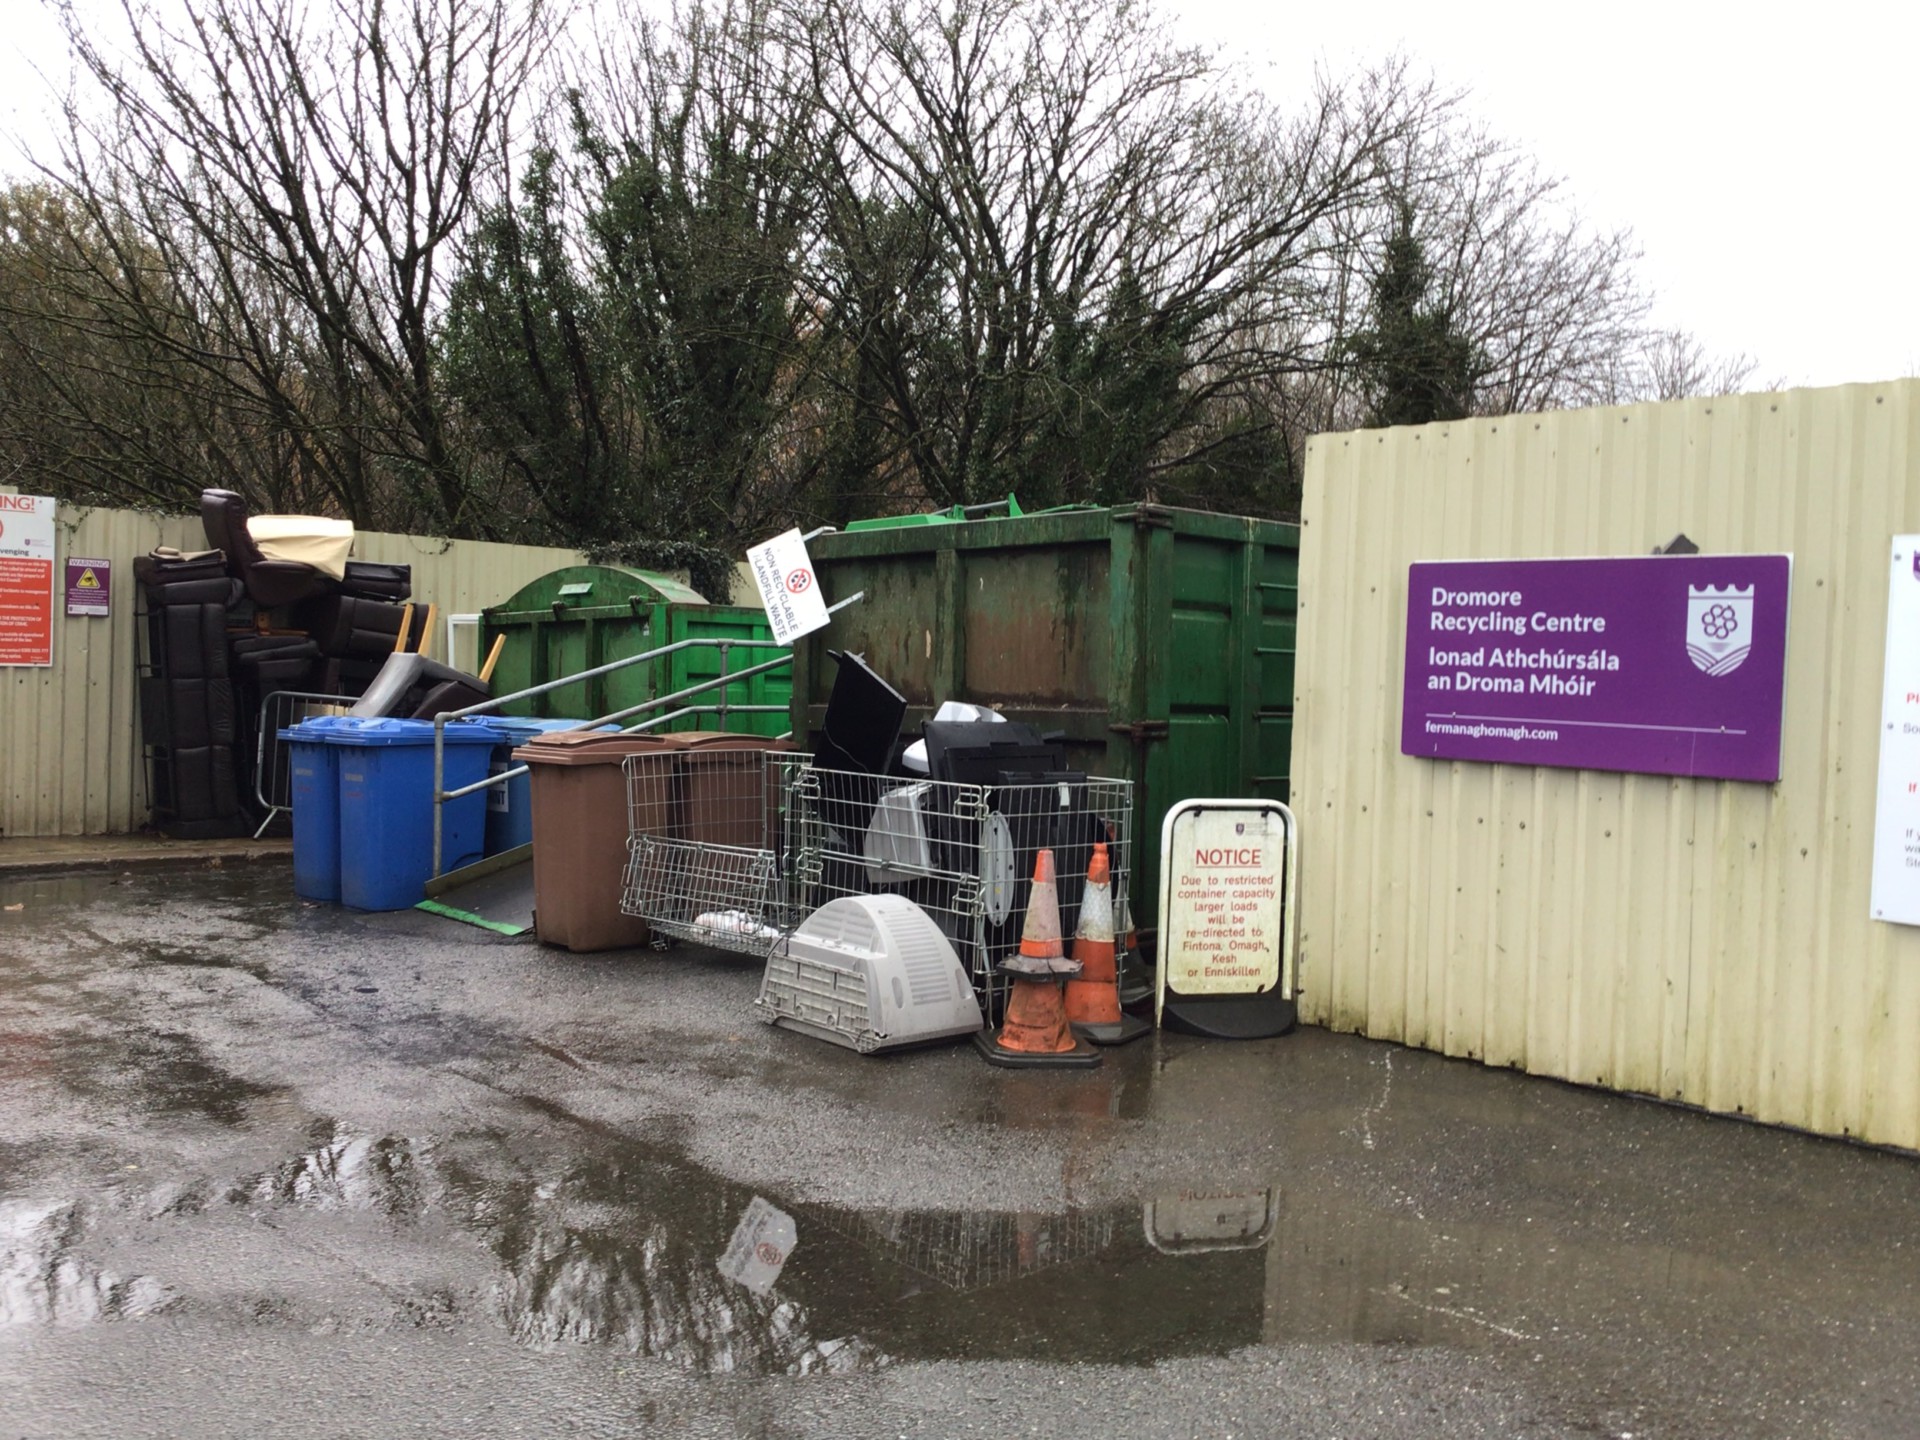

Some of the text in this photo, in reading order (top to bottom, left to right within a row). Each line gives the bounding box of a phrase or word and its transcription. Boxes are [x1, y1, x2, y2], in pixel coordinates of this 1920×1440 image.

[764, 547, 799, 632] NON RECYCLABLE
[1431, 587, 1522, 607] Dromore
[770, 603, 788, 639] WASTE
[1430, 611, 1606, 636] Recycling Centre
[1429, 646, 1620, 671] Ionad Athchúrsála
[1427, 671, 1596, 696] an Droma Mhóir
[1425, 720, 1559, 741] fermanaghomagh.com
[1195, 848, 1262, 866] NOTICE
[1181, 875, 1274, 886] Due to restricted
[1177, 888, 1276, 900] container capacity
[1194, 901, 1258, 914] larger loads
[1207, 915, 1245, 925] will be
[1186, 927, 1263, 938] re-directed to
[1211, 954, 1237, 964] Kesh
[1187, 965, 1261, 977] or Enniskillen
